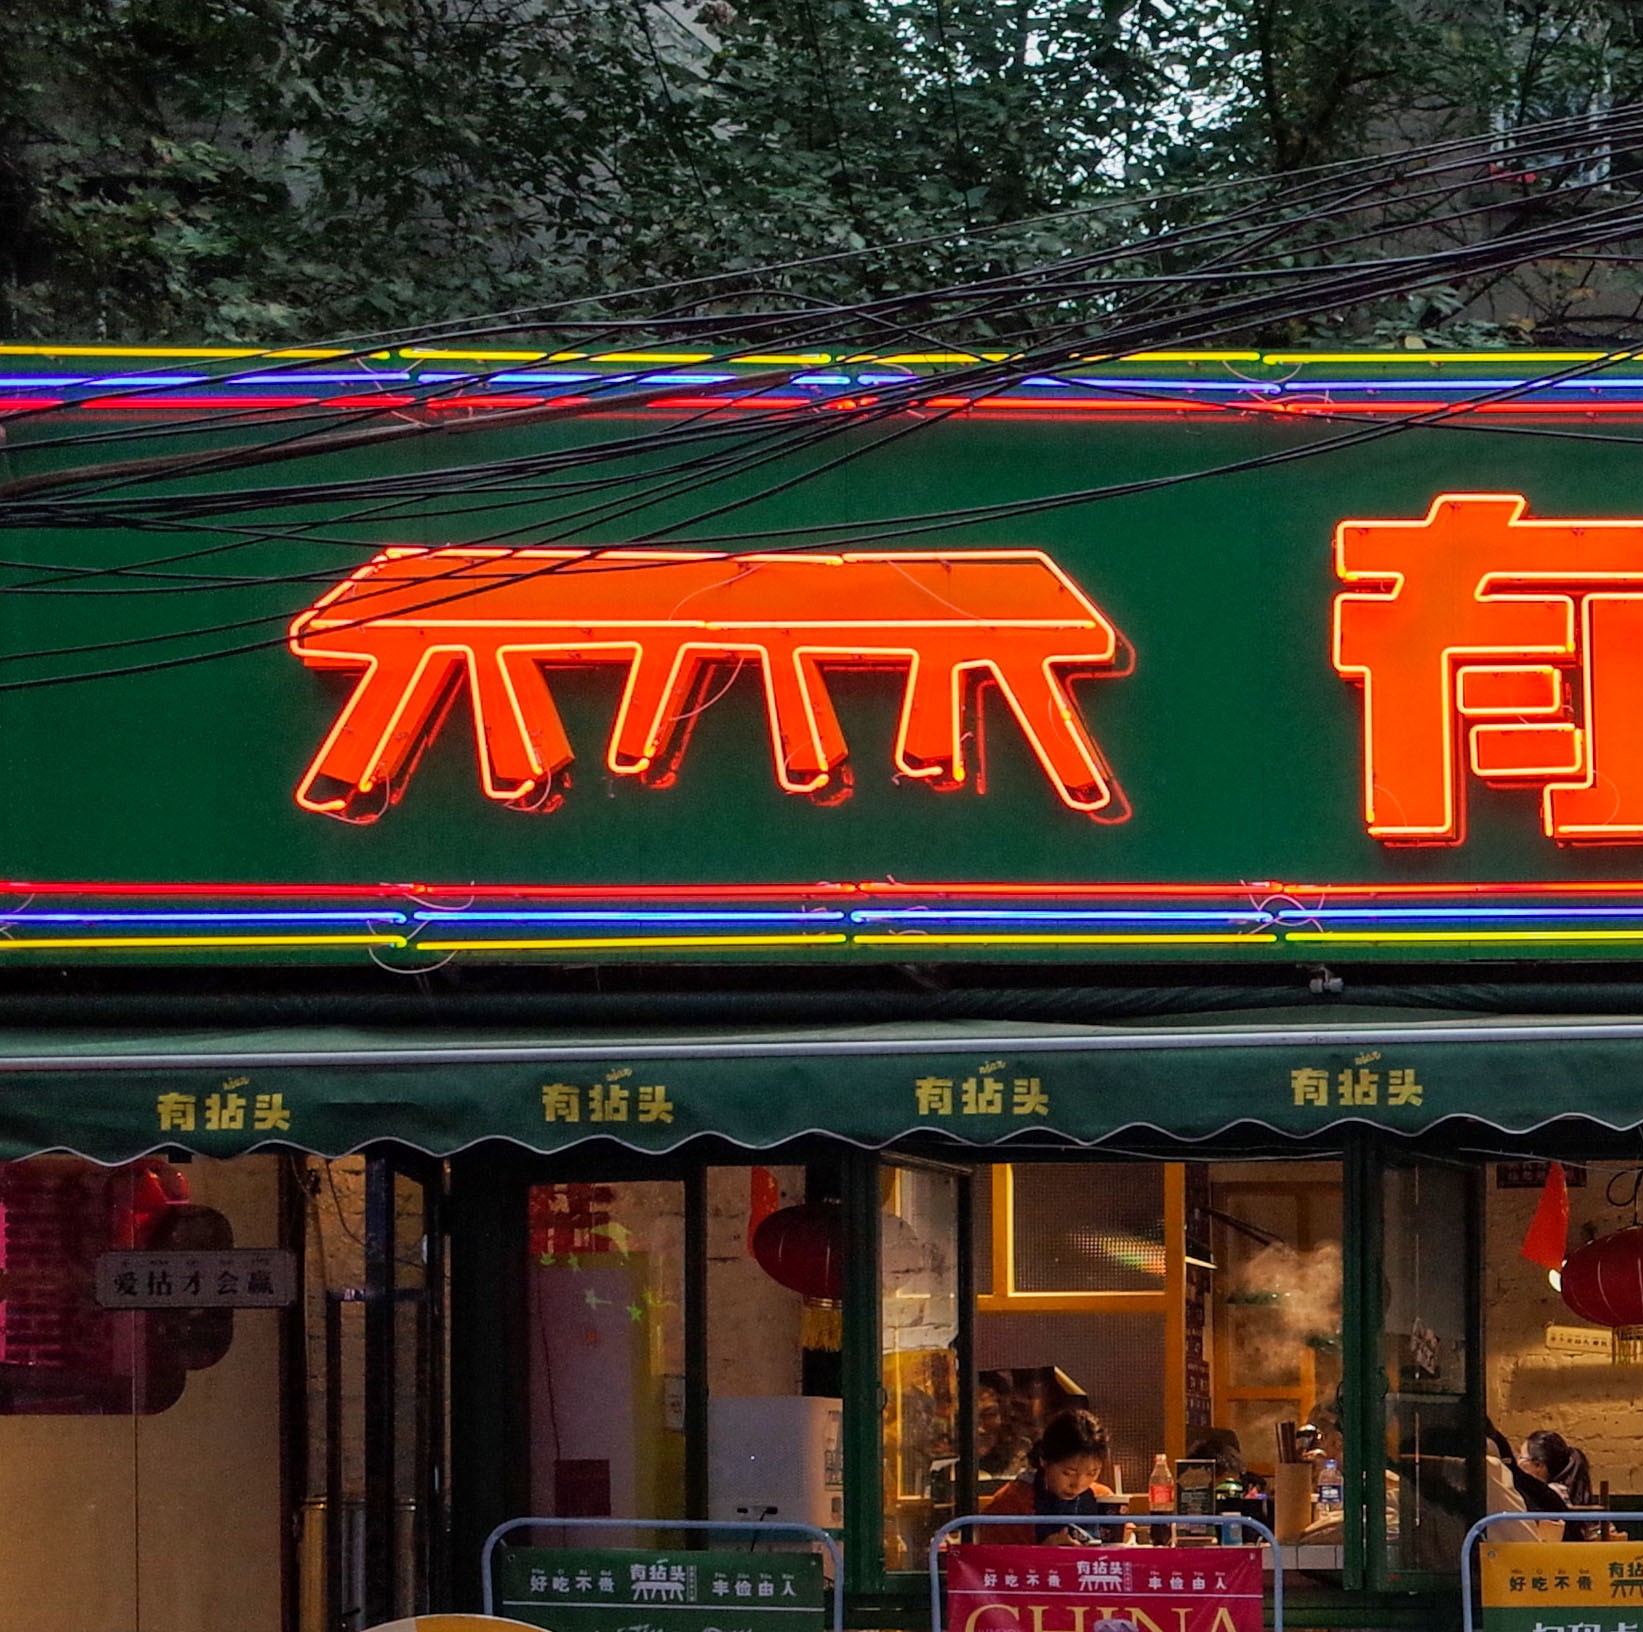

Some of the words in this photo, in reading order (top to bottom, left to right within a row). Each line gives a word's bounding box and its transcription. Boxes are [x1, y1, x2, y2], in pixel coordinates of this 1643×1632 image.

[916, 1077, 1048, 1114] 有拈头
[1291, 1068, 1423, 1105] 有拈头
[158, 1093, 289, 1131] 有拈头
[543, 1084, 673, 1122] 有拈头
[630, 1563, 686, 1582] 有拈头
[1076, 1560, 1124, 1576] 有拈头
[530, 1575, 615, 1593] 好吃不贵
[712, 1580, 797, 1597] 丰俭由人
[984, 1574, 1062, 1588] 好吃不贵
[1148, 1576, 1228, 1590] 丰俭由人
[1509, 1576, 1593, 1592] 好吃不贵
